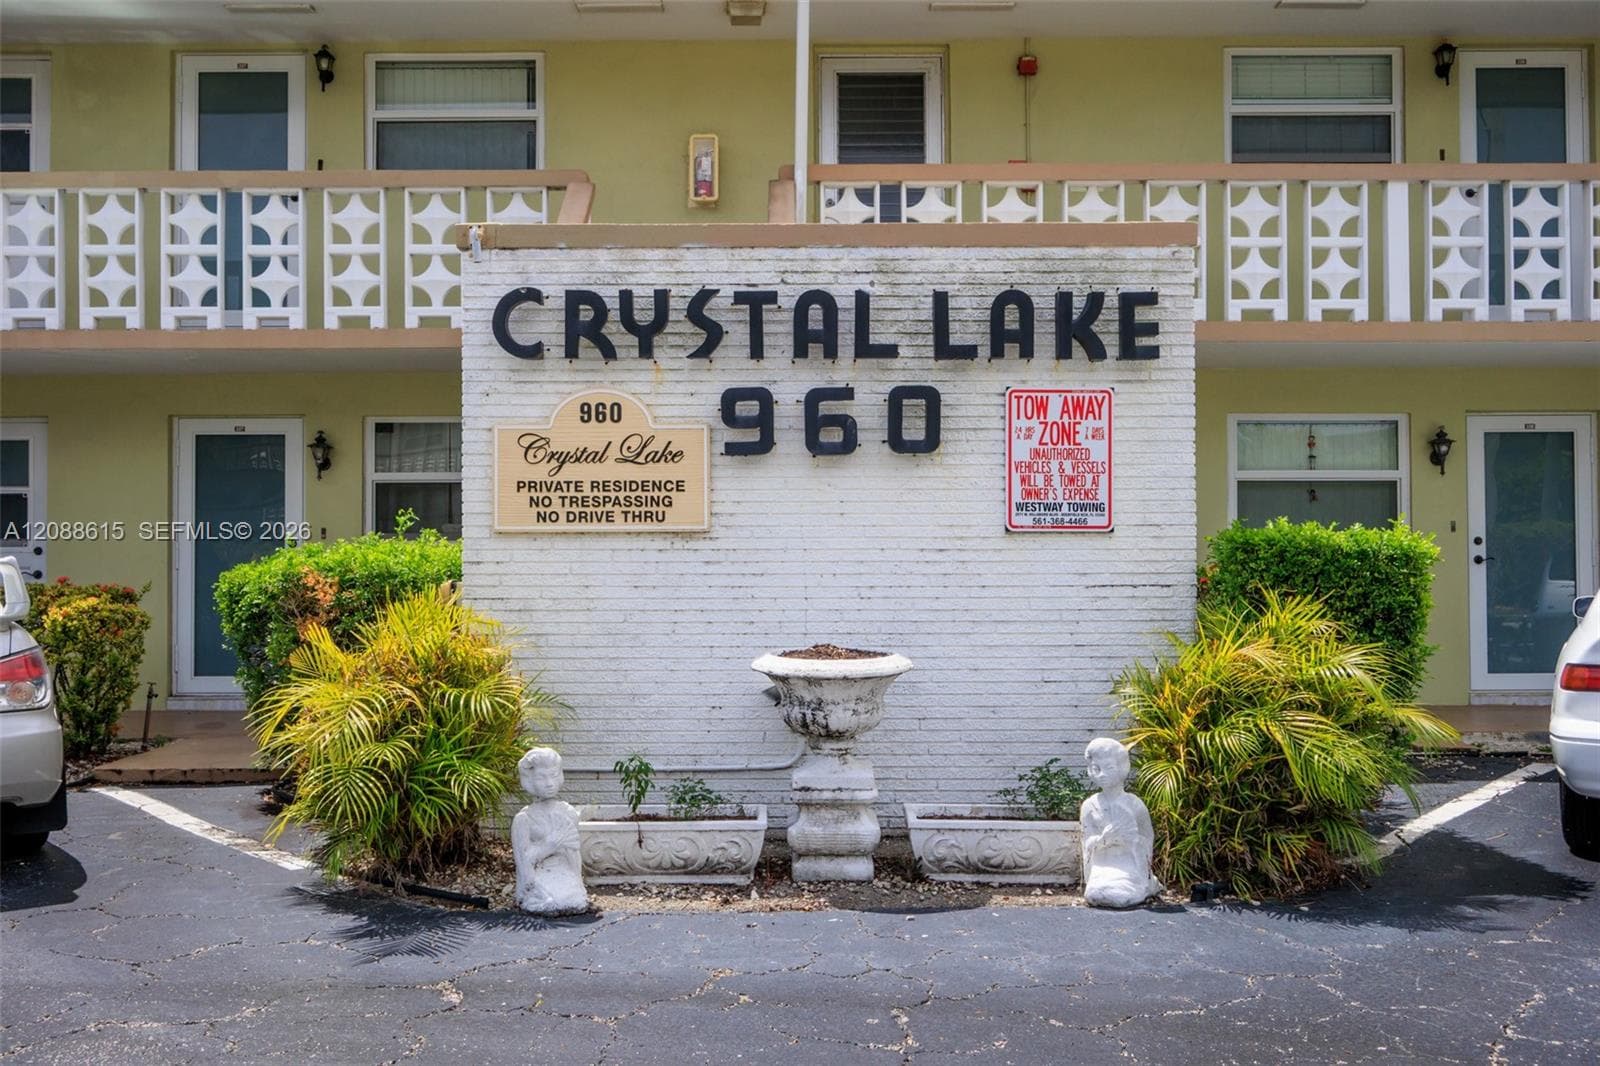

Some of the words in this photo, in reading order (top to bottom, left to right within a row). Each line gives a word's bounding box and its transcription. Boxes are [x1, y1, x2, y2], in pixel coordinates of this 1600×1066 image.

[492, 286, 899, 361] CRYSTAL
[933, 289, 1160, 361] LAKE
[579, 402, 622, 423] 960
[1014, 395, 1049, 420] TOW
[1059, 395, 1106, 420] AWAY
[720, 384, 942, 456] 960
[1038, 422, 1082, 446] ZONE
[517, 433, 612, 477] Crystal
[614, 433, 684, 465] Lake
[1030, 448, 1090, 460] UNAUTHORIZED
[1014, 461, 1051, 474] VEHICLES
[1058, 461, 1065, 474] &
[1071, 462, 1106, 474] VESSELS
[517, 480, 584, 493] PRIVATE
[591, 480, 685, 492] RESIDENCE
[1020, 475, 1038, 487] WILL
[1044, 475, 1054, 487] BE
[1060, 475, 1086, 487] TOWED
[1091, 475, 1100, 487] AT
[1021, 488, 1058, 501] OWNER'S
[1063, 488, 1099, 501] EXPENSE
[529, 496, 553, 507] NO
[558, 496, 673, 508] TRESPASSING
[1016, 502, 1064, 512] WESTWAY
[1068, 502, 1105, 512] TOWING
[536, 511, 559, 523] NO
[566, 511, 615, 523] DRIVE
[621, 511, 666, 523] THRU
